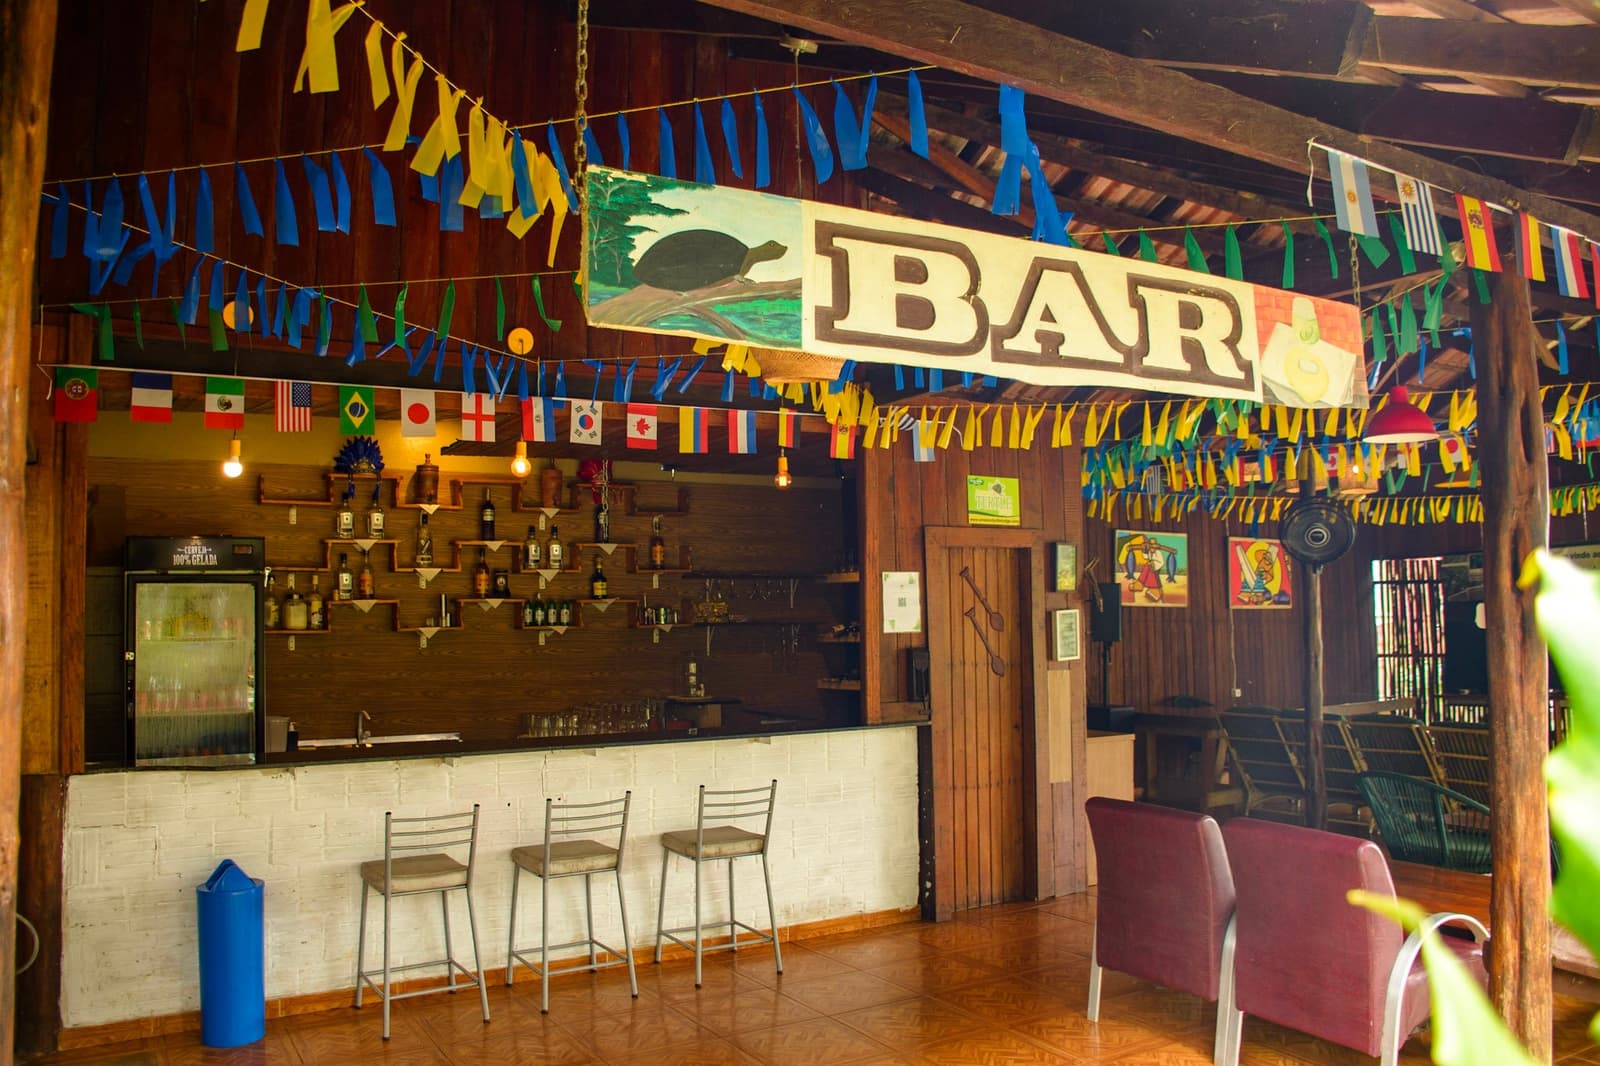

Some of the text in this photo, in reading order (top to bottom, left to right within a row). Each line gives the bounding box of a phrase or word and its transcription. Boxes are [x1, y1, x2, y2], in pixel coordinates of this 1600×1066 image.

[815, 220, 1255, 390] BAR
[173, 554, 218, 565] 100% GELADA
